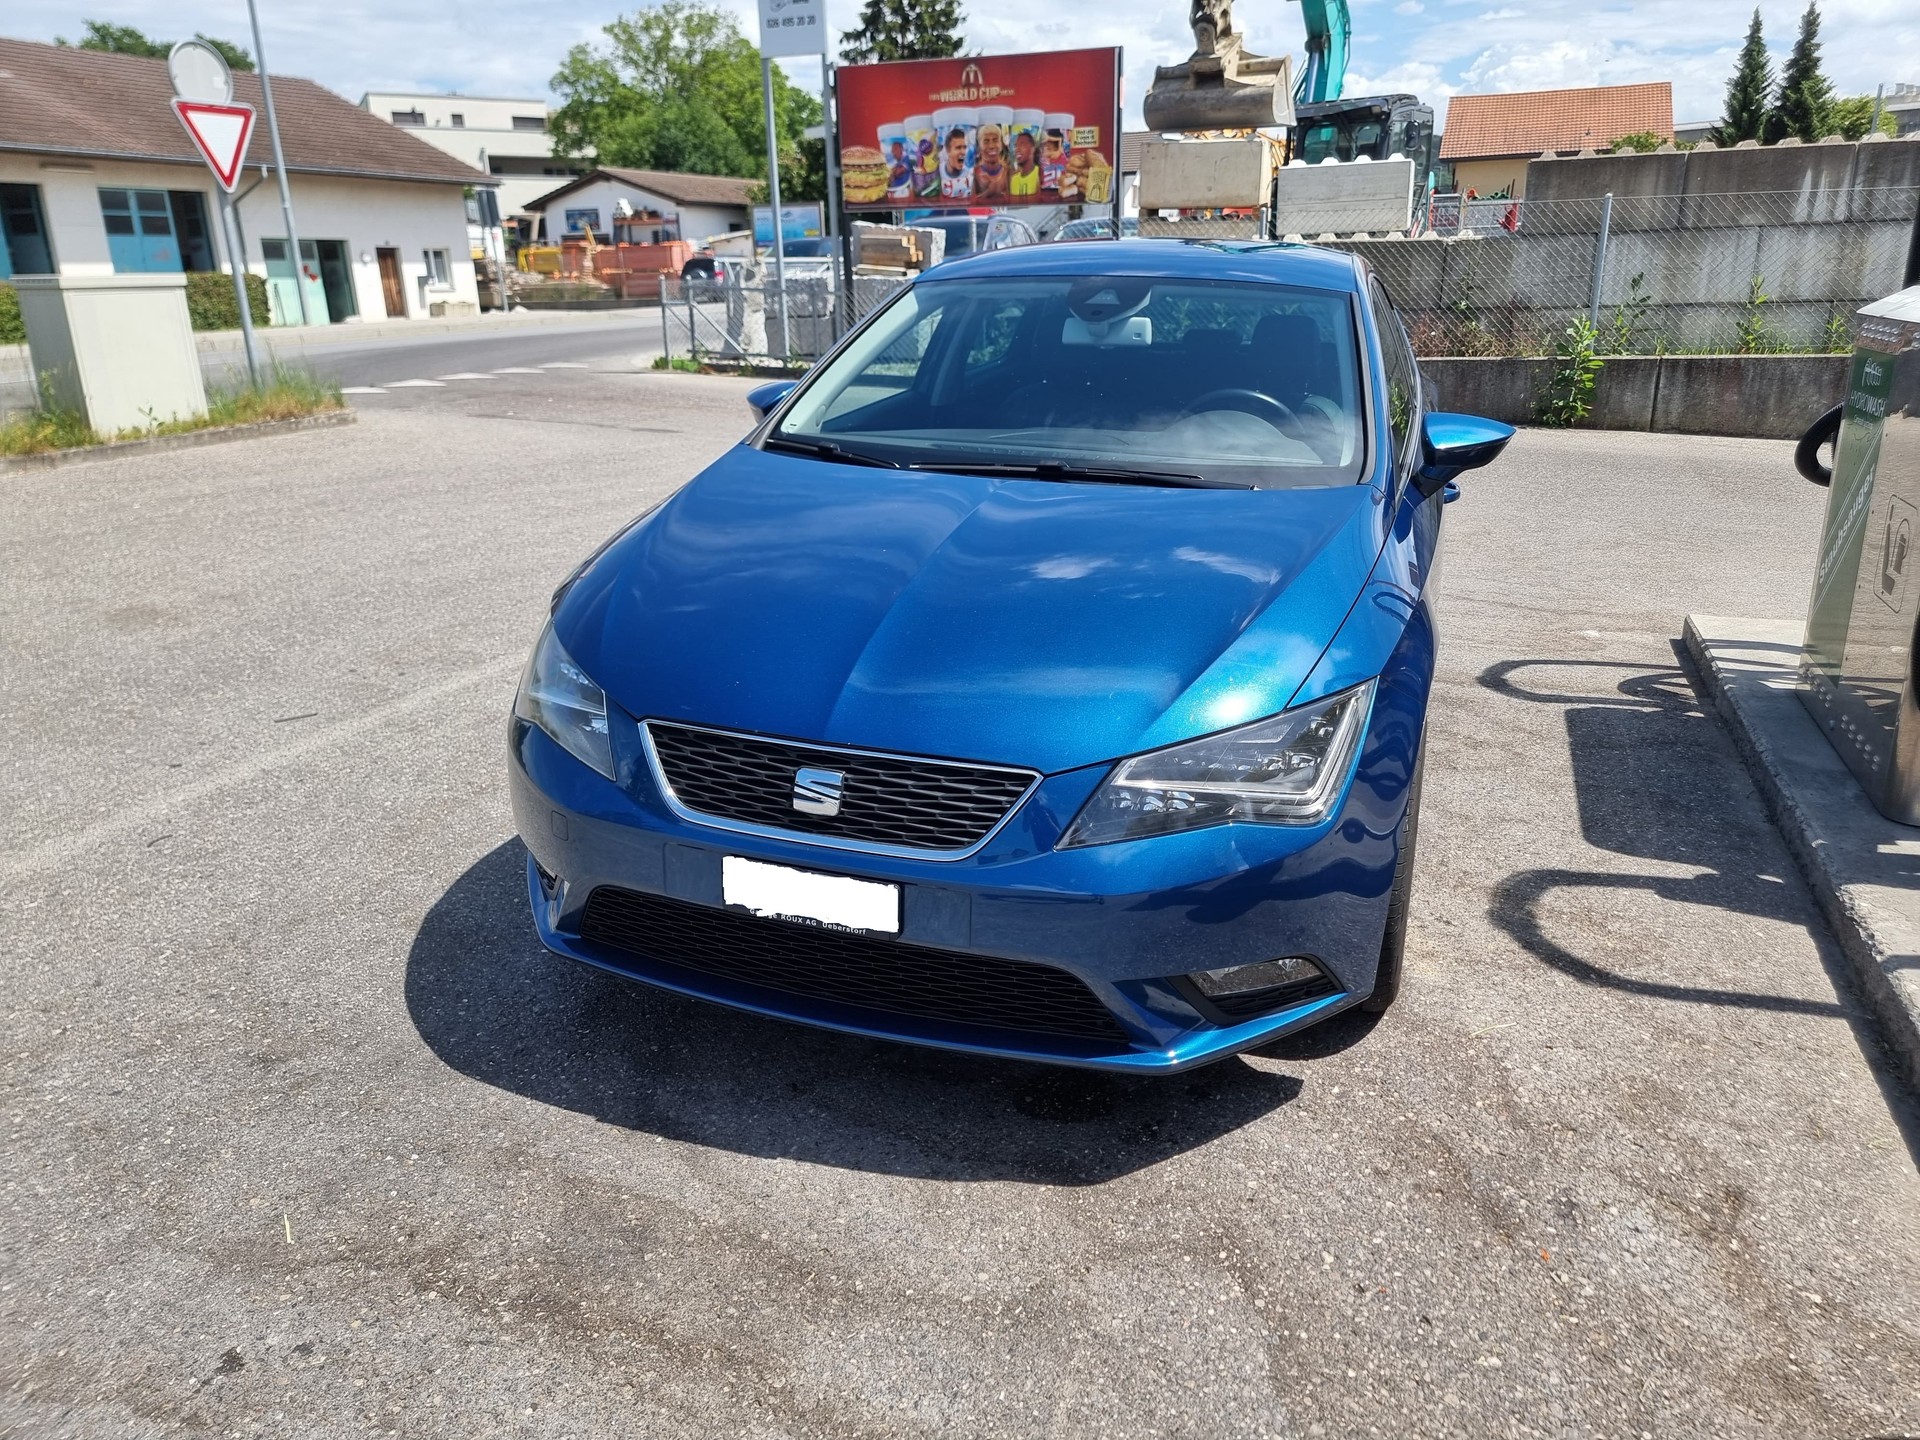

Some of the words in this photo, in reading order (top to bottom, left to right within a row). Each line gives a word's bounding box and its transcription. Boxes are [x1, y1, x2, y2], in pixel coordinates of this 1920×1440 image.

[940, 88, 977, 102] WORLD
[979, 86, 1001, 101] CUP
[1849, 389, 1887, 418] HYDROWASH
[1818, 462, 1876, 585] Staubsauger
[780, 914, 803, 924] ROUX
[805, 918, 817, 926] AG
[822, 922, 866, 935] Ueberstorf
